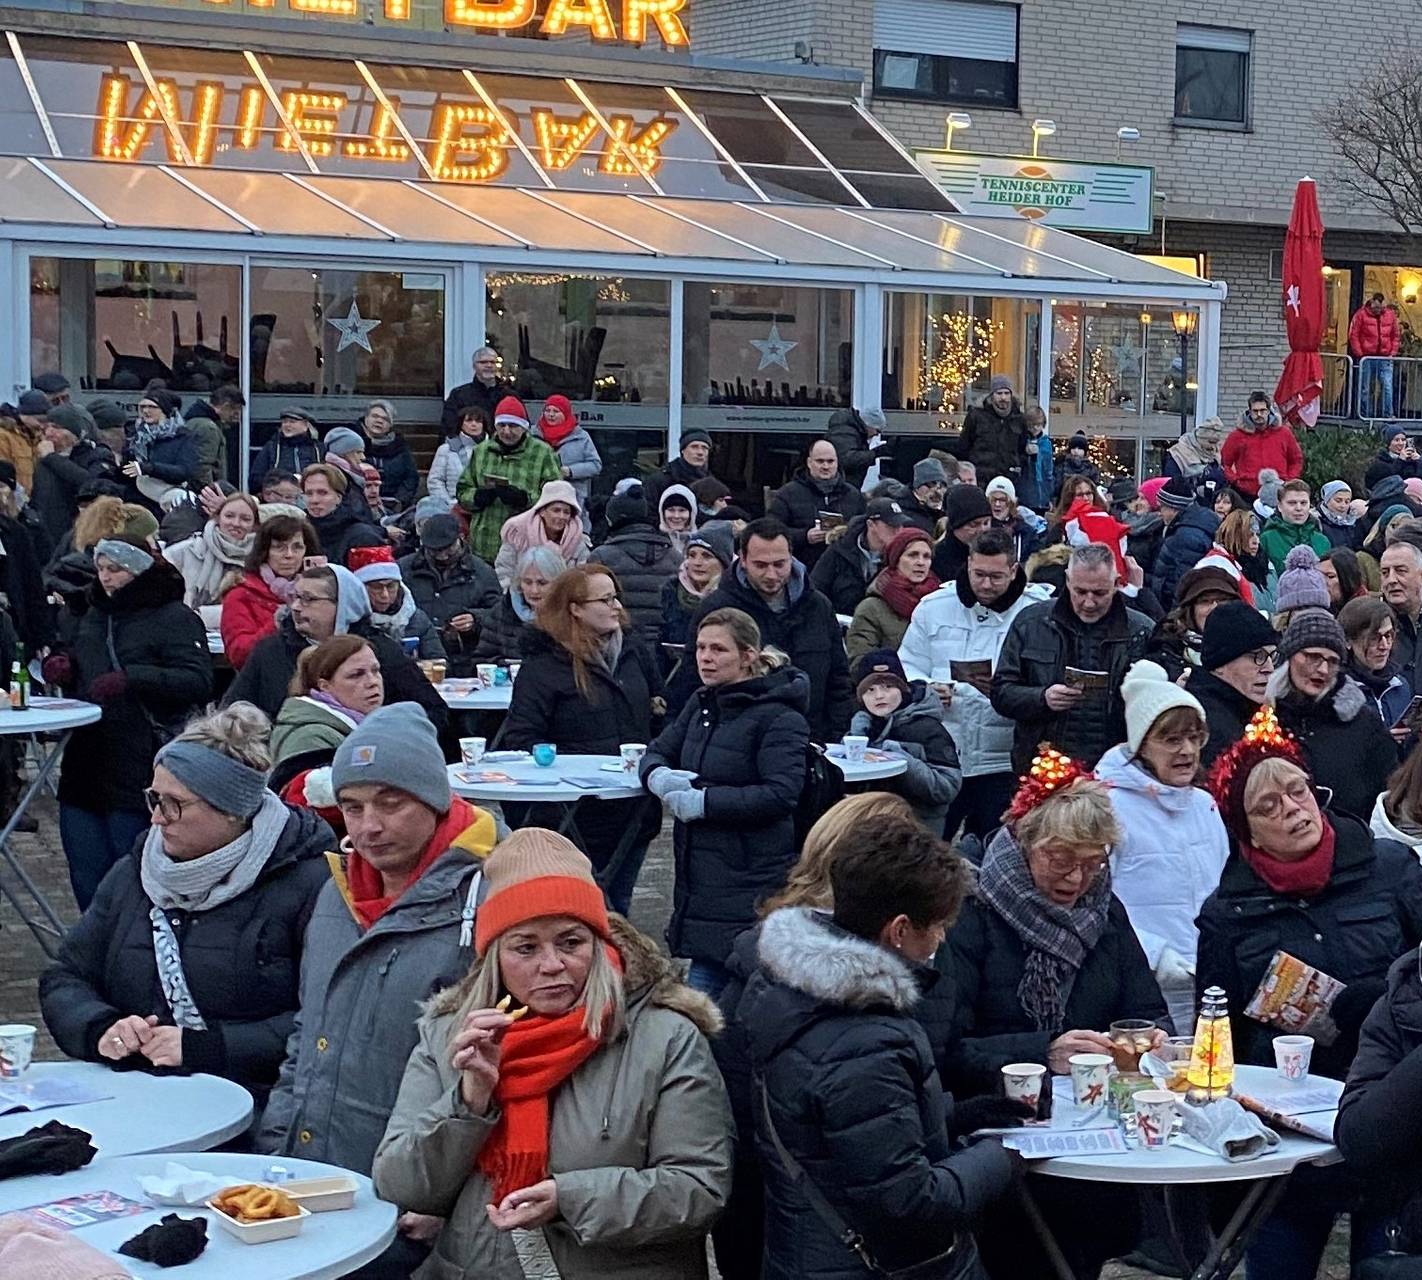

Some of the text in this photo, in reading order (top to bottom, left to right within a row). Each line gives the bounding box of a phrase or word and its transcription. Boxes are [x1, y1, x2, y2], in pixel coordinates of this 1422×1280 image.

[981, 177, 1086, 195] TENNISCENTER
[988, 192, 1074, 207] HEIDER HOF
